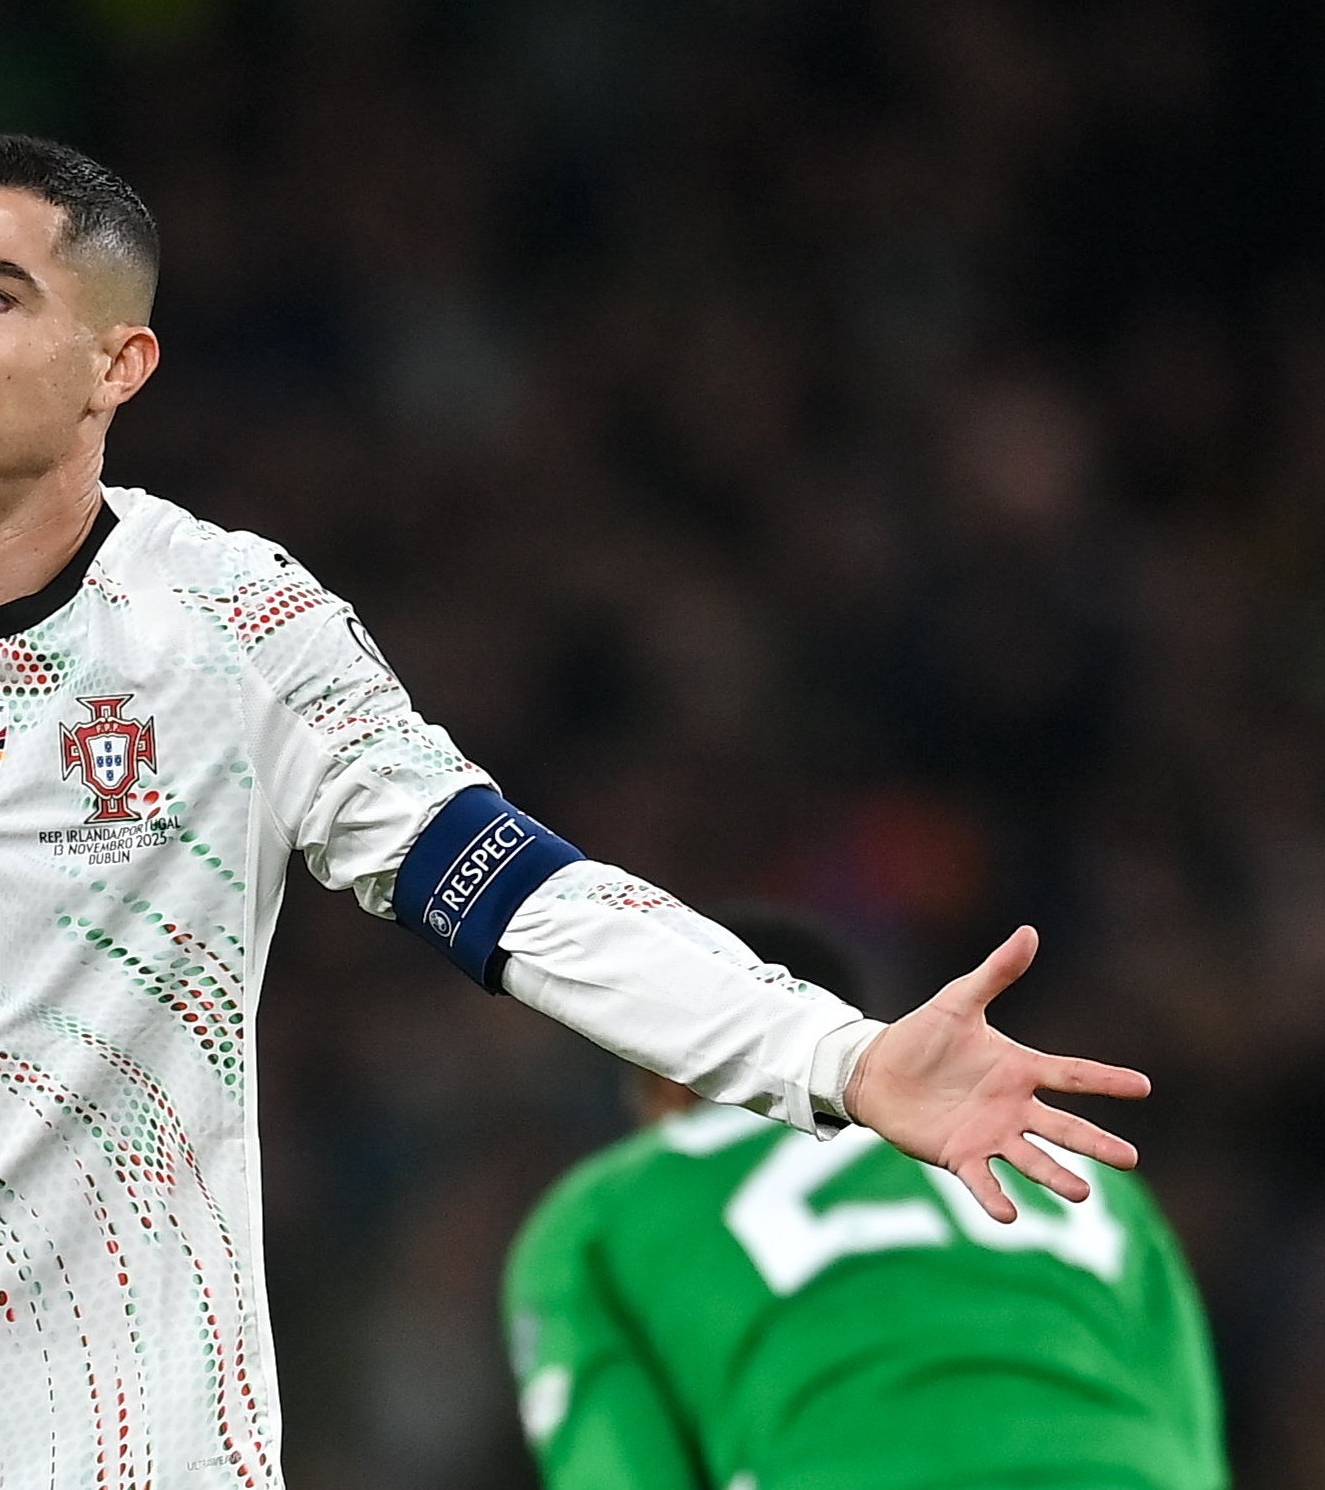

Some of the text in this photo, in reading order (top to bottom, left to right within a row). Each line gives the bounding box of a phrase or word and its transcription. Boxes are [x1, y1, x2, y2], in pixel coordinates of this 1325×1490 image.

[39, 815, 181, 843] REP. IRLANDA/PORTUGAL
[54, 832, 167, 856] 13 NOVEMBRO 2025
[88, 850, 131, 865] DUBLIN
[442, 818, 524, 911] RESPECT
